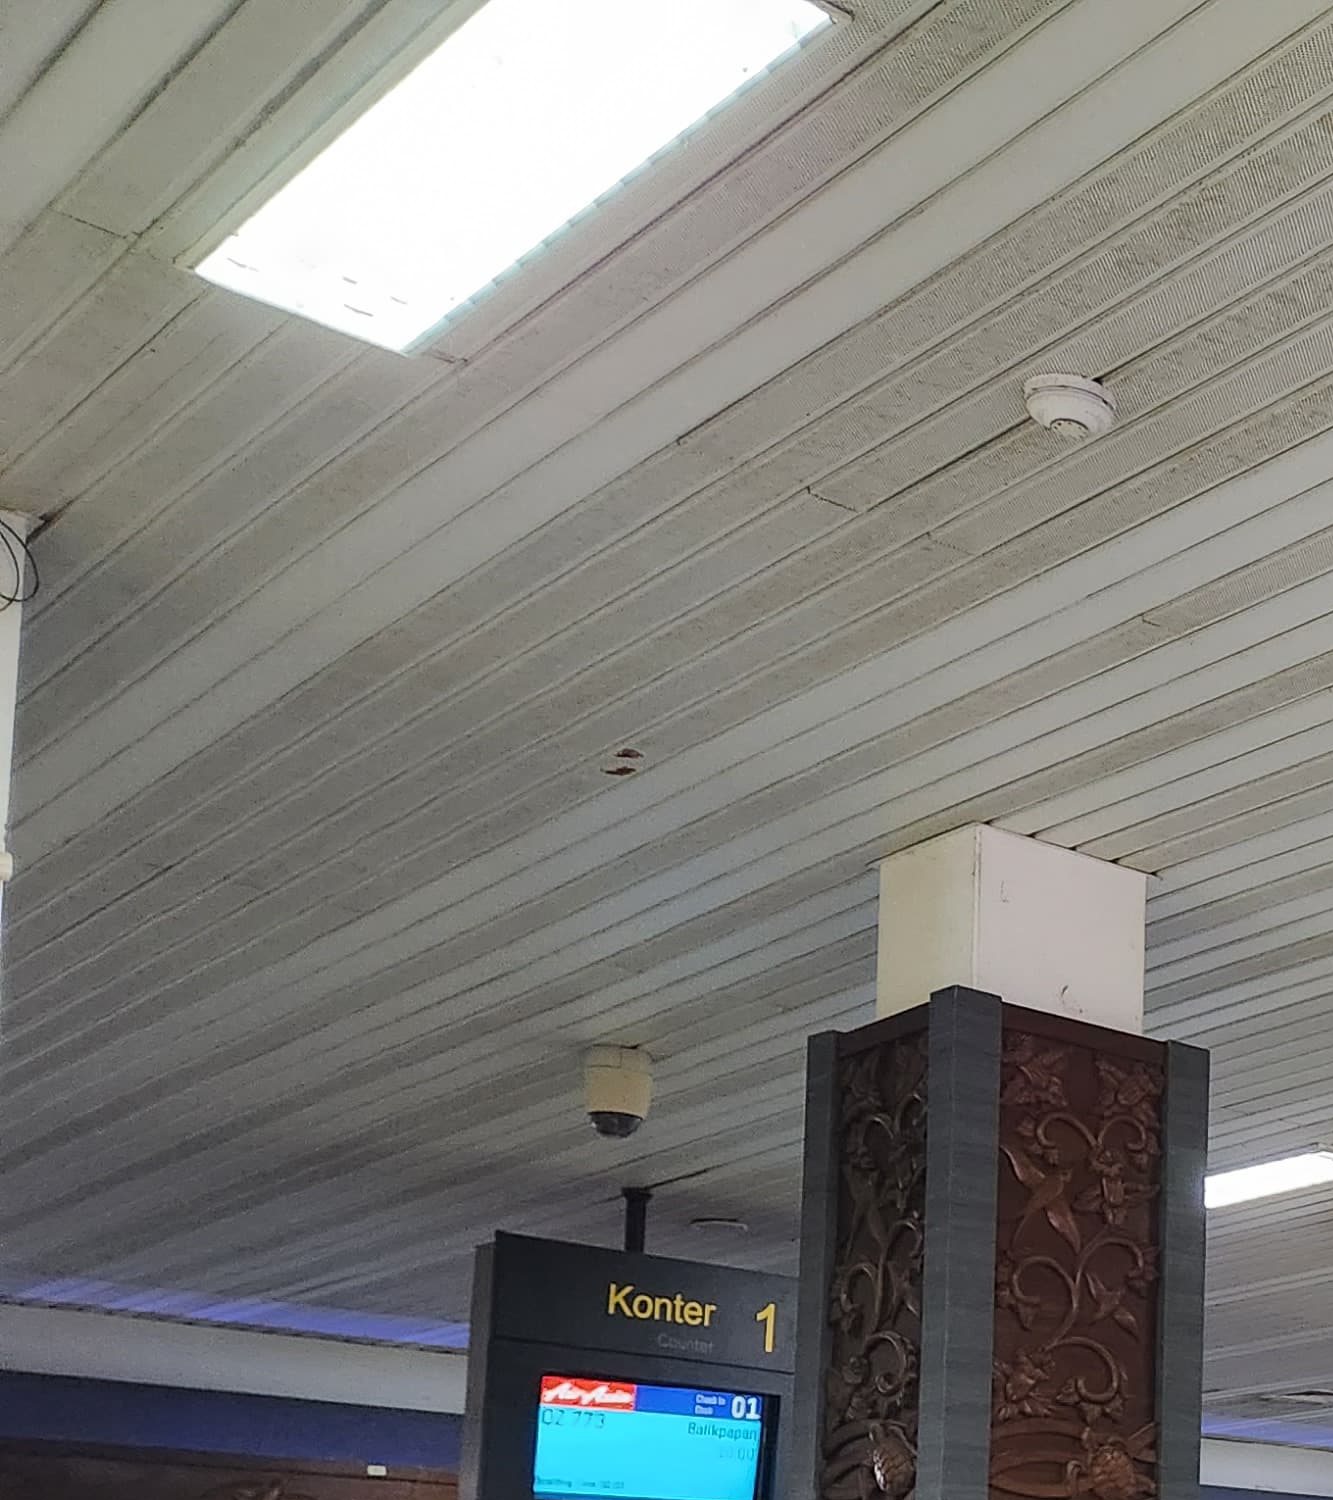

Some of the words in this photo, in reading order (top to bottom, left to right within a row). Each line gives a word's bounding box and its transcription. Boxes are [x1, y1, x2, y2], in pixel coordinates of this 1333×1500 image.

[608, 1283, 717, 1327] Konter
[756, 1303, 776, 1353] 1
[731, 1396, 761, 1420] 01
[688, 1421, 757, 1441] Balikpapan
